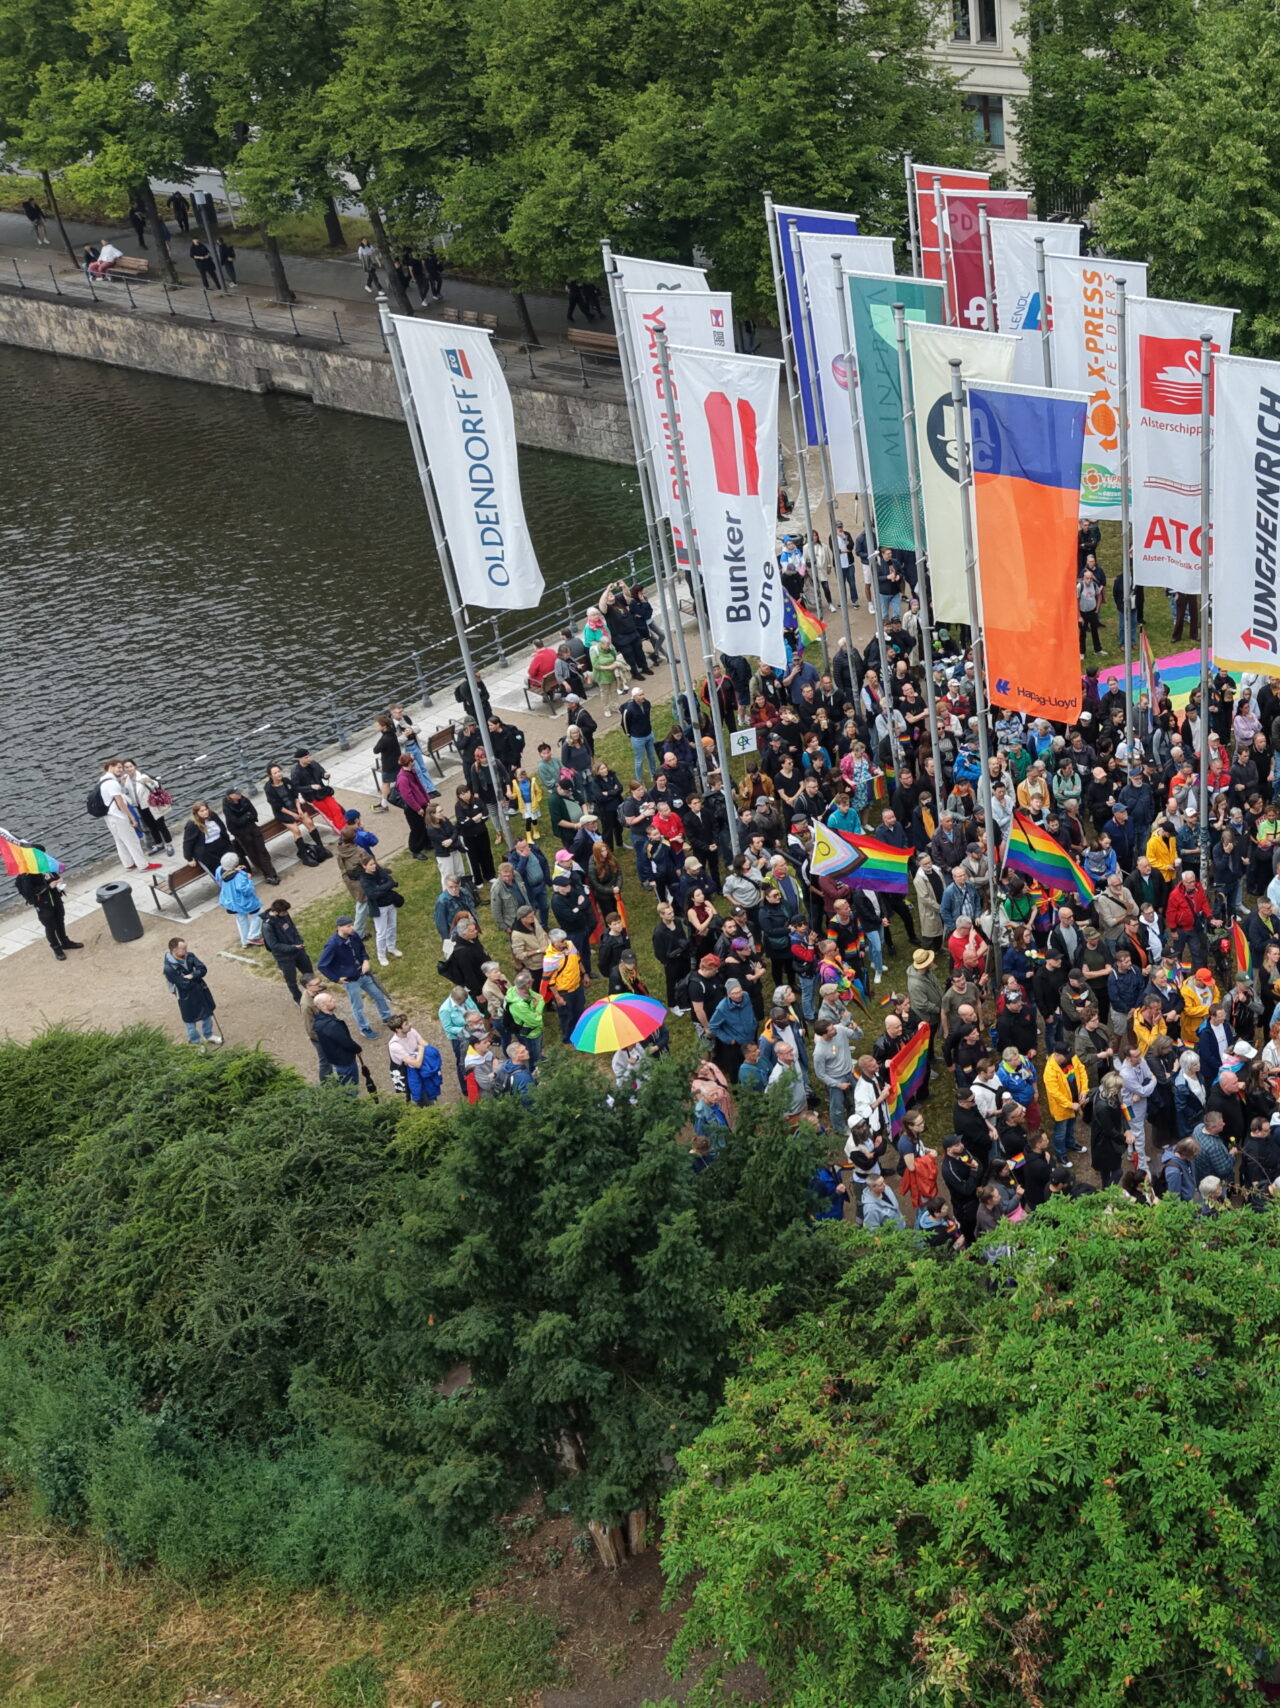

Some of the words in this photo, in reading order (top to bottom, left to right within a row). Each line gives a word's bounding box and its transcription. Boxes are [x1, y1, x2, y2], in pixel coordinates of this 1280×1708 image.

[1082, 269, 1106, 382] X-PRESS
[1103, 273, 1119, 388] FEEDERS
[456, 382, 508, 588] OLDENDORFF
[725, 510, 751, 624] Bunker
[758, 561, 775, 629] One
[1017, 686, 1078, 709] Hapag-Lloyd
